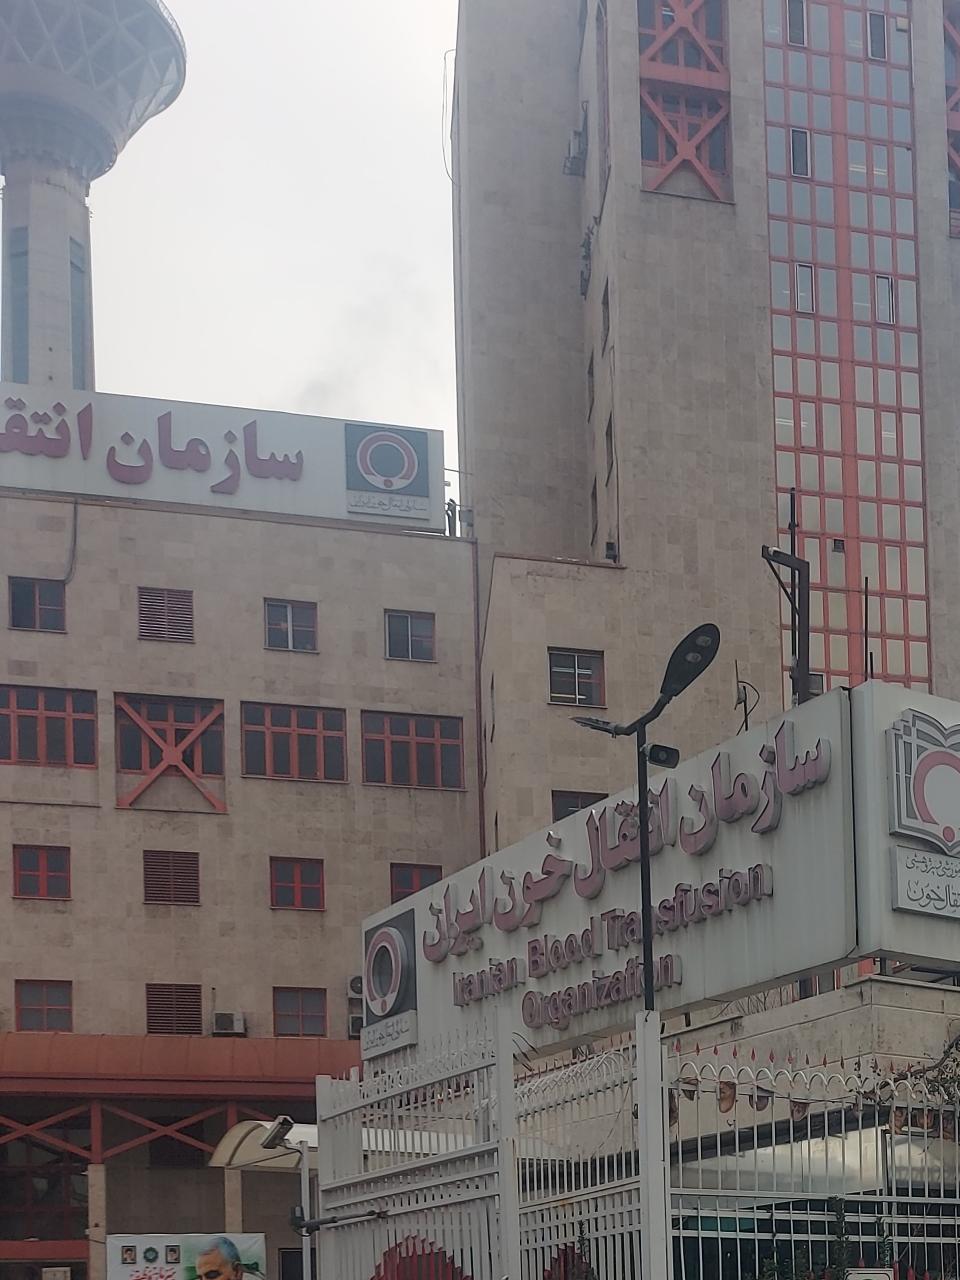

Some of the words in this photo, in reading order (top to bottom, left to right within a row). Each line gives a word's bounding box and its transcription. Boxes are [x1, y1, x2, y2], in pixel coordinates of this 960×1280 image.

[107, 411, 304, 495] سازمان
[678, 720, 832, 855] سازمان
[422, 864, 494, 964] ایران
[493, 831, 574, 934] خون
[452, 957, 526, 1007] Iranian
[528, 917, 603, 979] Blood
[521, 954, 683, 1031] Organizatin
